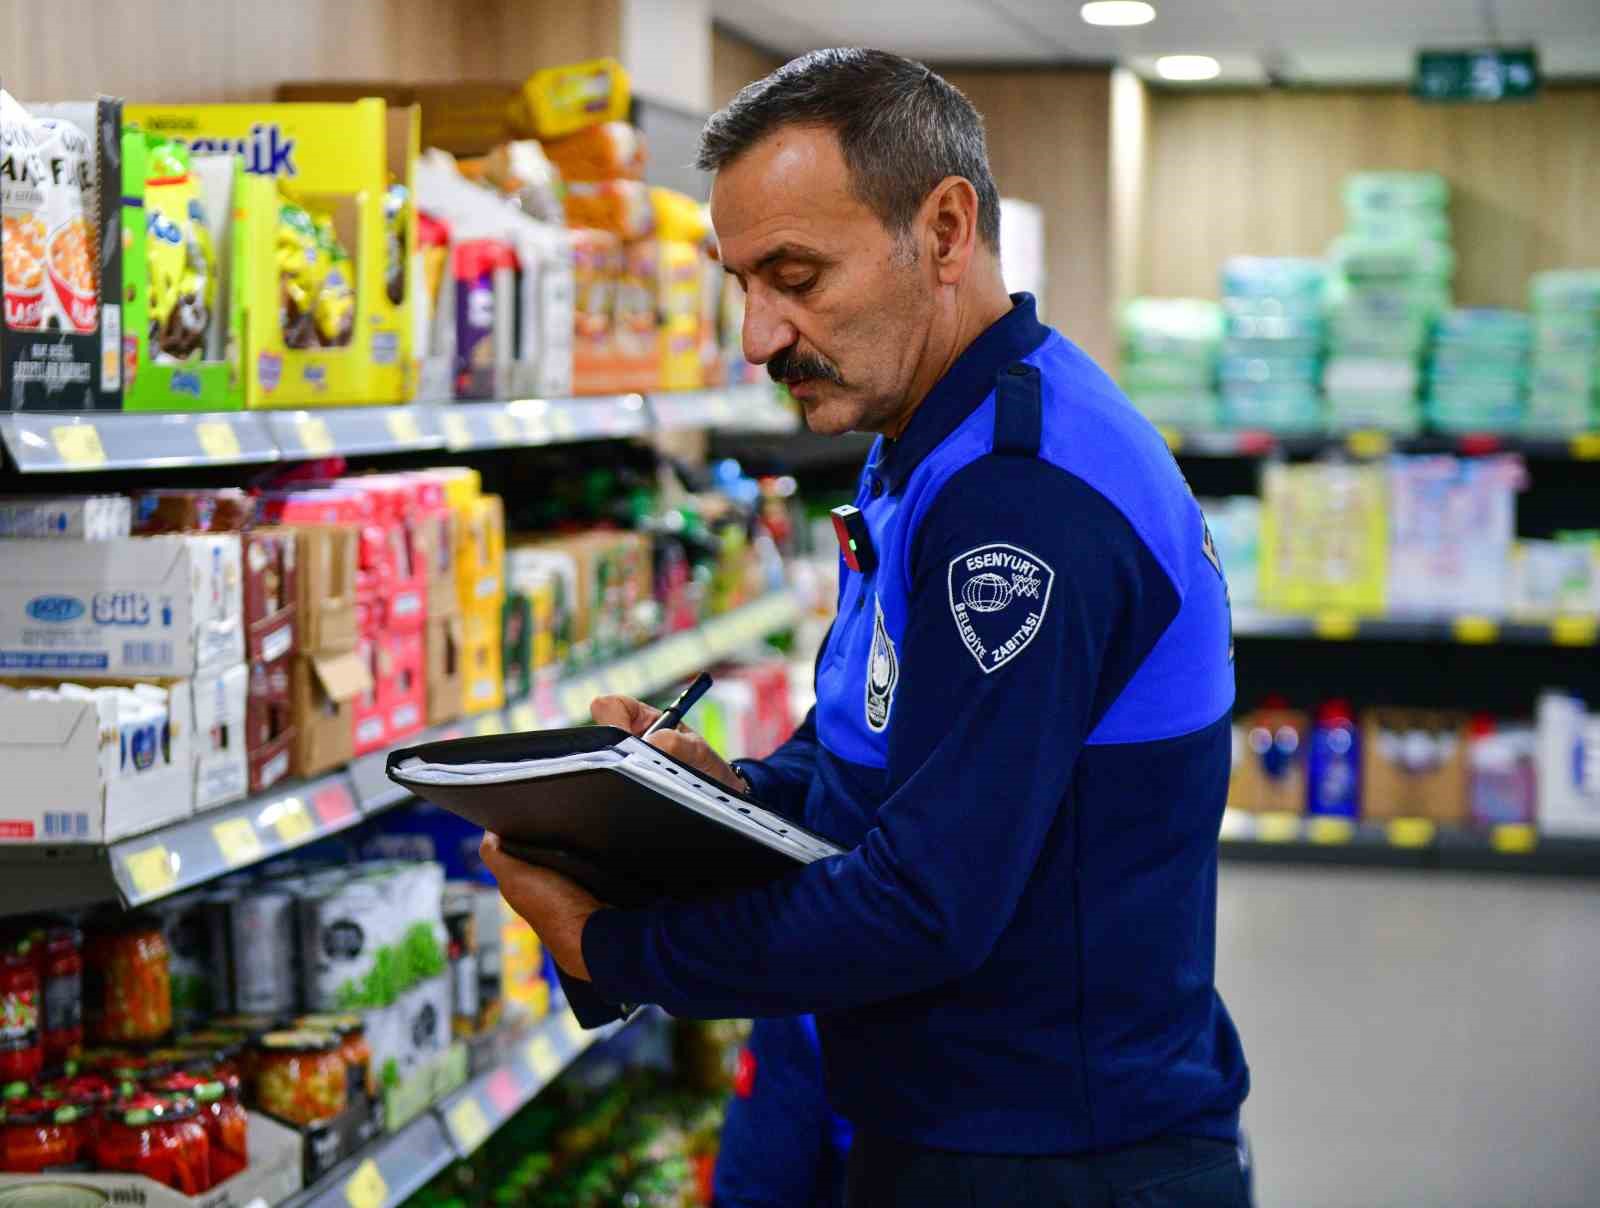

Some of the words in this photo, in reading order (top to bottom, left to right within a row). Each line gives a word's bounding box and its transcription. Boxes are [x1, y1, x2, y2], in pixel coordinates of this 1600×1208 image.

[966, 552, 1040, 578] ESENYURT
[955, 602, 987, 659] BELEDİYE
[991, 612, 1040, 662] ZABITASI
